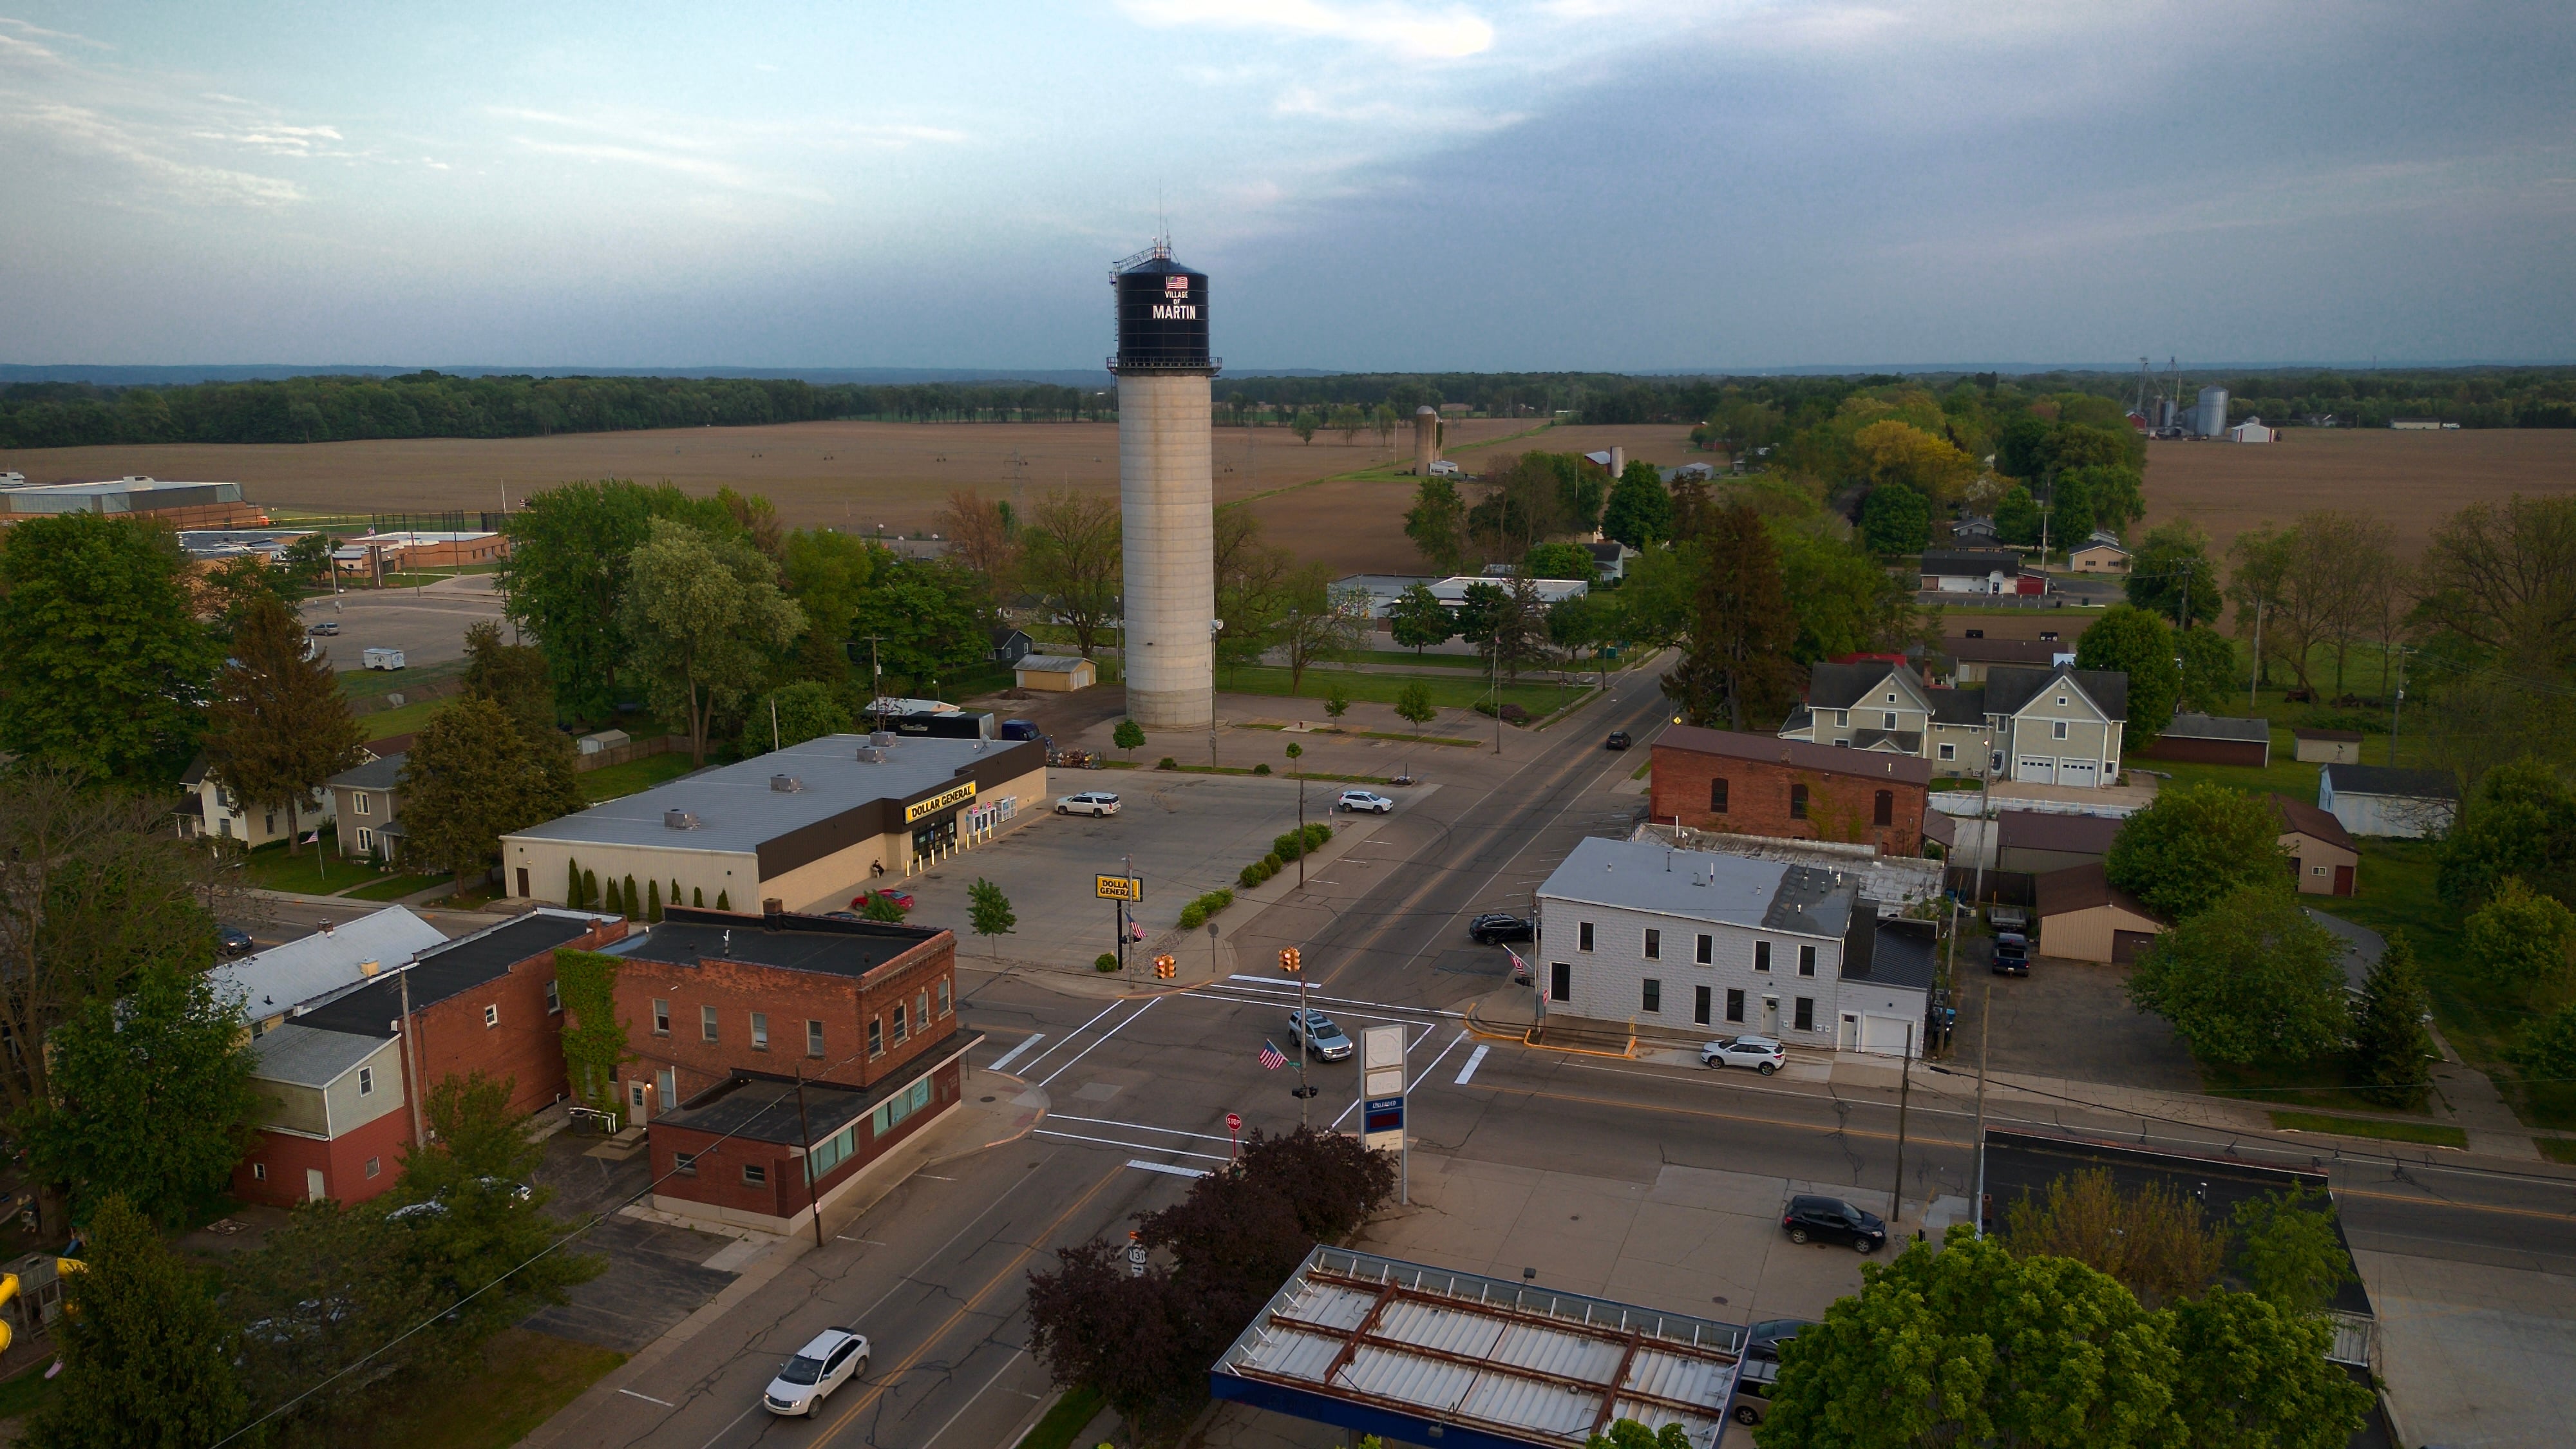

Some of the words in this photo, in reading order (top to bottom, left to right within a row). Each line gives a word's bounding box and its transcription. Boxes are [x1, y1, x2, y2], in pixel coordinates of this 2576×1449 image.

[1164, 290, 1188, 299] VILLAGE
[1153, 305, 1196, 319] MARTIN
[911, 799, 940, 818] DOLLAR
[941, 786, 972, 806] GENERAL
[1102, 880, 1133, 889] DOLLA
[1227, 1117, 1240, 1126] STOP
[1132, 1250, 1144, 1261] 131
